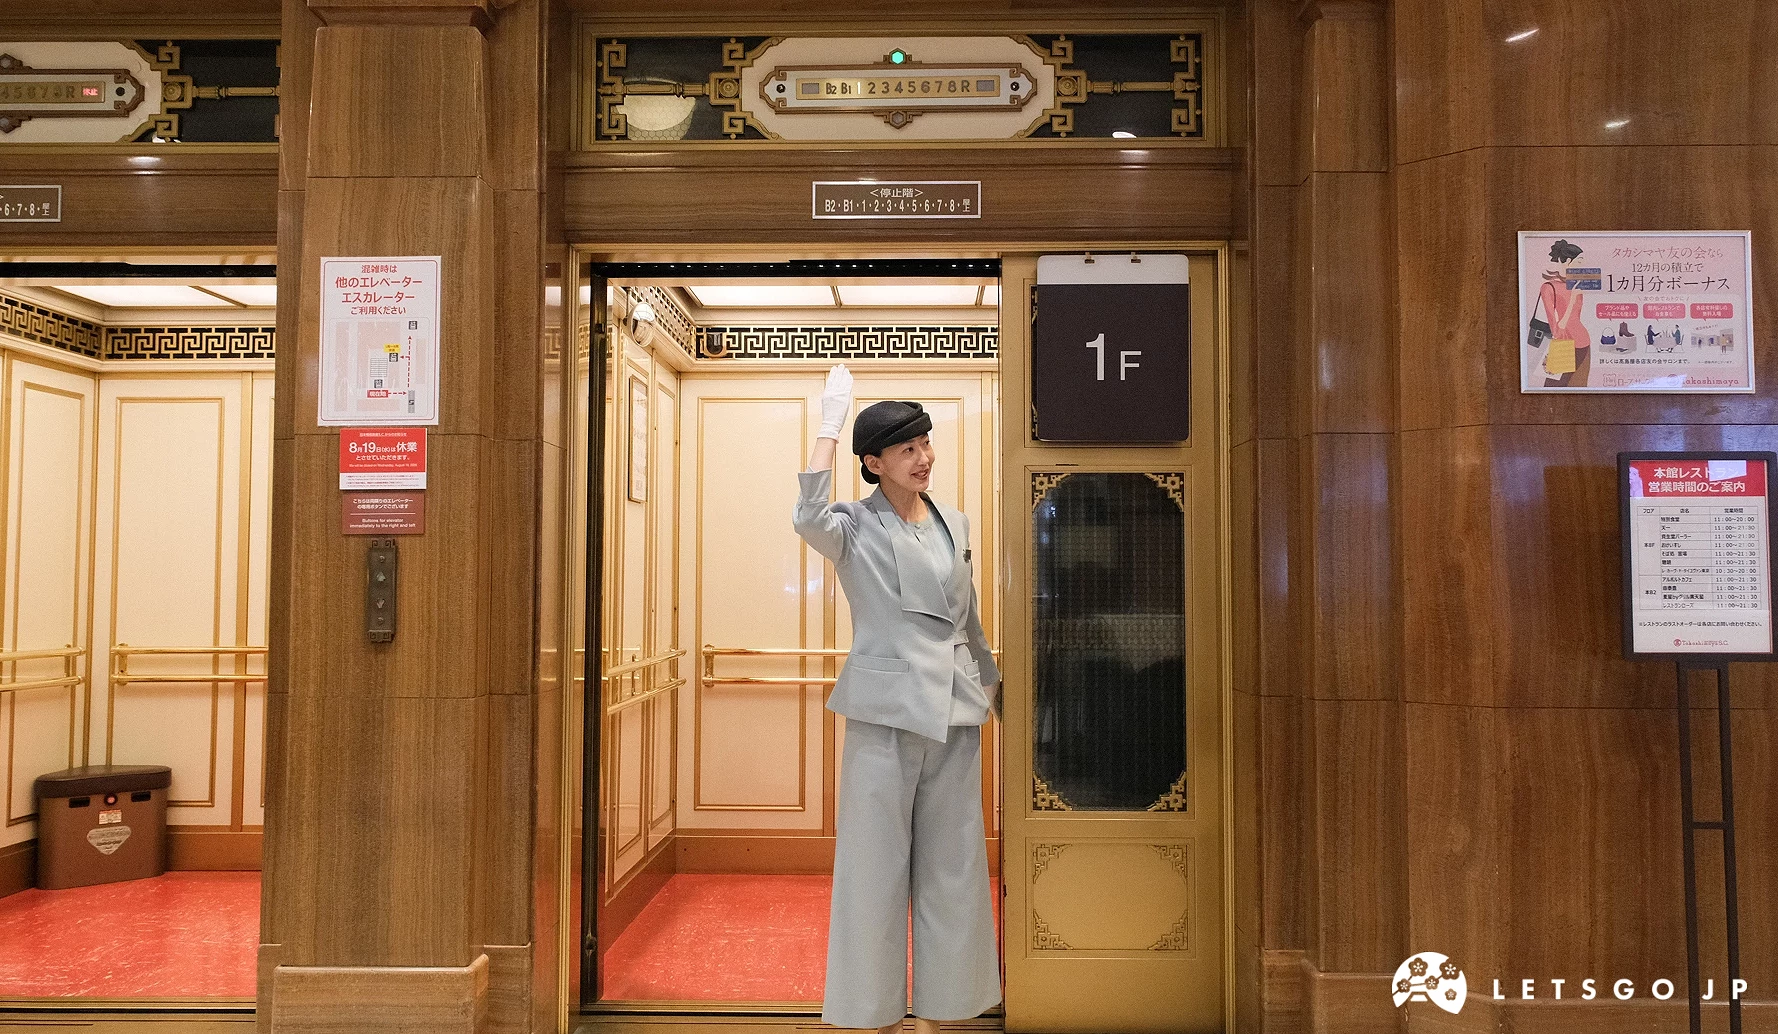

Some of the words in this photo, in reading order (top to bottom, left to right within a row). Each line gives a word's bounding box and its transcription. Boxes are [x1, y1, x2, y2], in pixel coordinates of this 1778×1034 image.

[826, 82, 837, 95] B2
[841, 83, 852, 95] B1
[857, 82, 861, 95] 1
[868, 82, 876, 94] 2
[881, 82, 890, 94] 3
[894, 81, 903, 93] 4
[908, 81, 916, 93] 5
[921, 81, 930, 93] 6
[934, 81, 942, 93] 7
[947, 80, 956, 92] 8
[961, 80, 970, 92] R
[1612, 246, 1723, 259] タカシマヤ友の会なら
[362, 265, 397, 273] 混雑時は
[336, 276, 422, 288] 他のエレベーター
[1607, 274, 1730, 292] 1カ月分ボーナス
[342, 292, 415, 304] エスカレーター
[351, 306, 406, 315] ご利用ください
[1683, 377, 1739, 386] akashimaya
[1648, 481, 1746, 492] 営業時間のご案内
